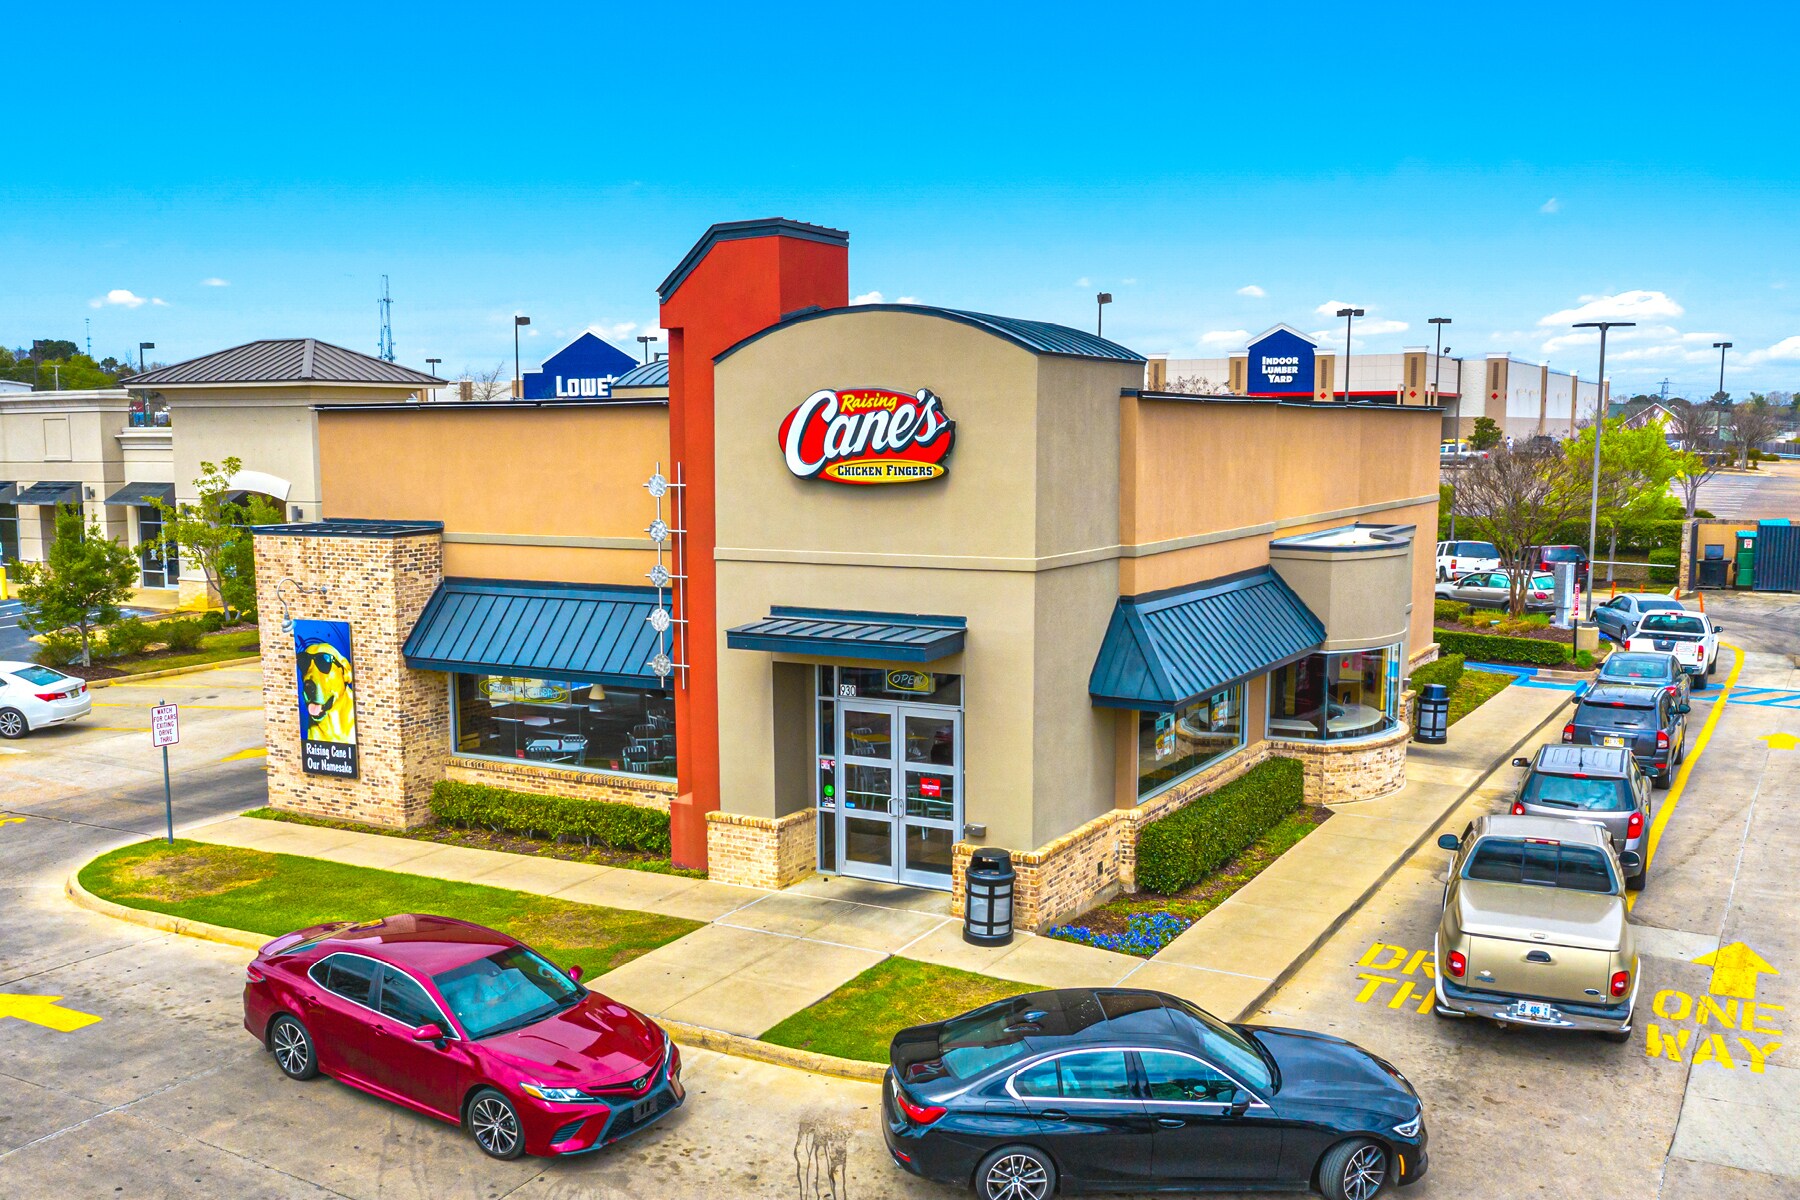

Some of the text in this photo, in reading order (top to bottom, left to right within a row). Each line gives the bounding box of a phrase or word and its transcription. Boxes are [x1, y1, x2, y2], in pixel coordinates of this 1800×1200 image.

[1262, 356, 1299, 365] INDOOR
[1262, 365, 1299, 374] LUMBER
[1267, 374, 1293, 383] YARD
[840, 393, 898, 412] Raising
[785, 388, 949, 476] Cane's
[837, 464, 934, 476] CHICKEN FINGERS
[892, 673, 924, 685] OPEN
[840, 685, 856, 696] 930
[156, 720, 174, 729] EXITING
[158, 728, 173, 736] DRIVE
[160, 735, 173, 743] THRU
[306, 742, 330, 760] Raising
[331, 745, 347, 759] Cane
[307, 757, 353, 774] Our Namesake
[1652, 989, 1785, 1036] ONE
[1645, 1023, 1783, 1075] WAY
